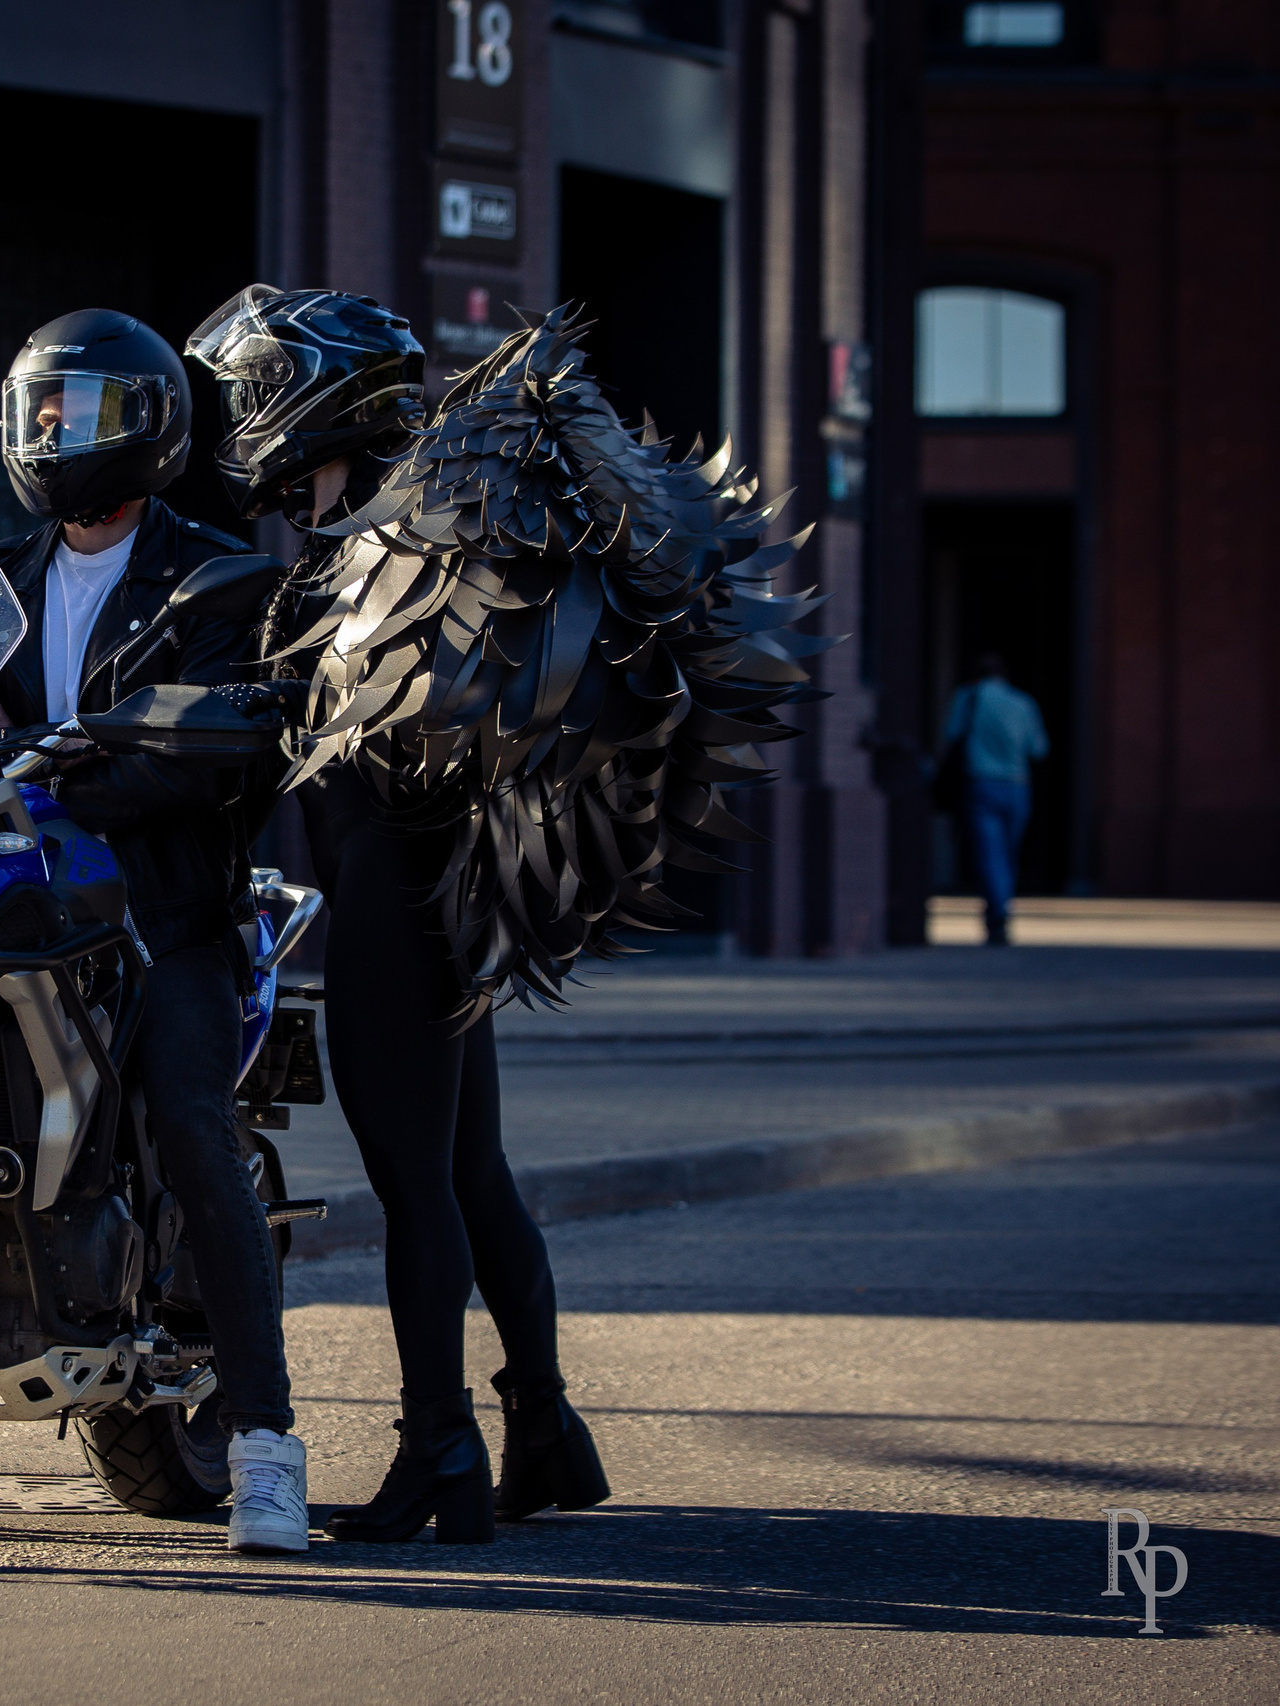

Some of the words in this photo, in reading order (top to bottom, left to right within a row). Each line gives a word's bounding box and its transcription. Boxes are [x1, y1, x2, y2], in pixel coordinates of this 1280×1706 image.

[446, 0, 513, 87] 18
[28, 345, 86, 359] LS2
[158, 432, 188, 469] LS2
